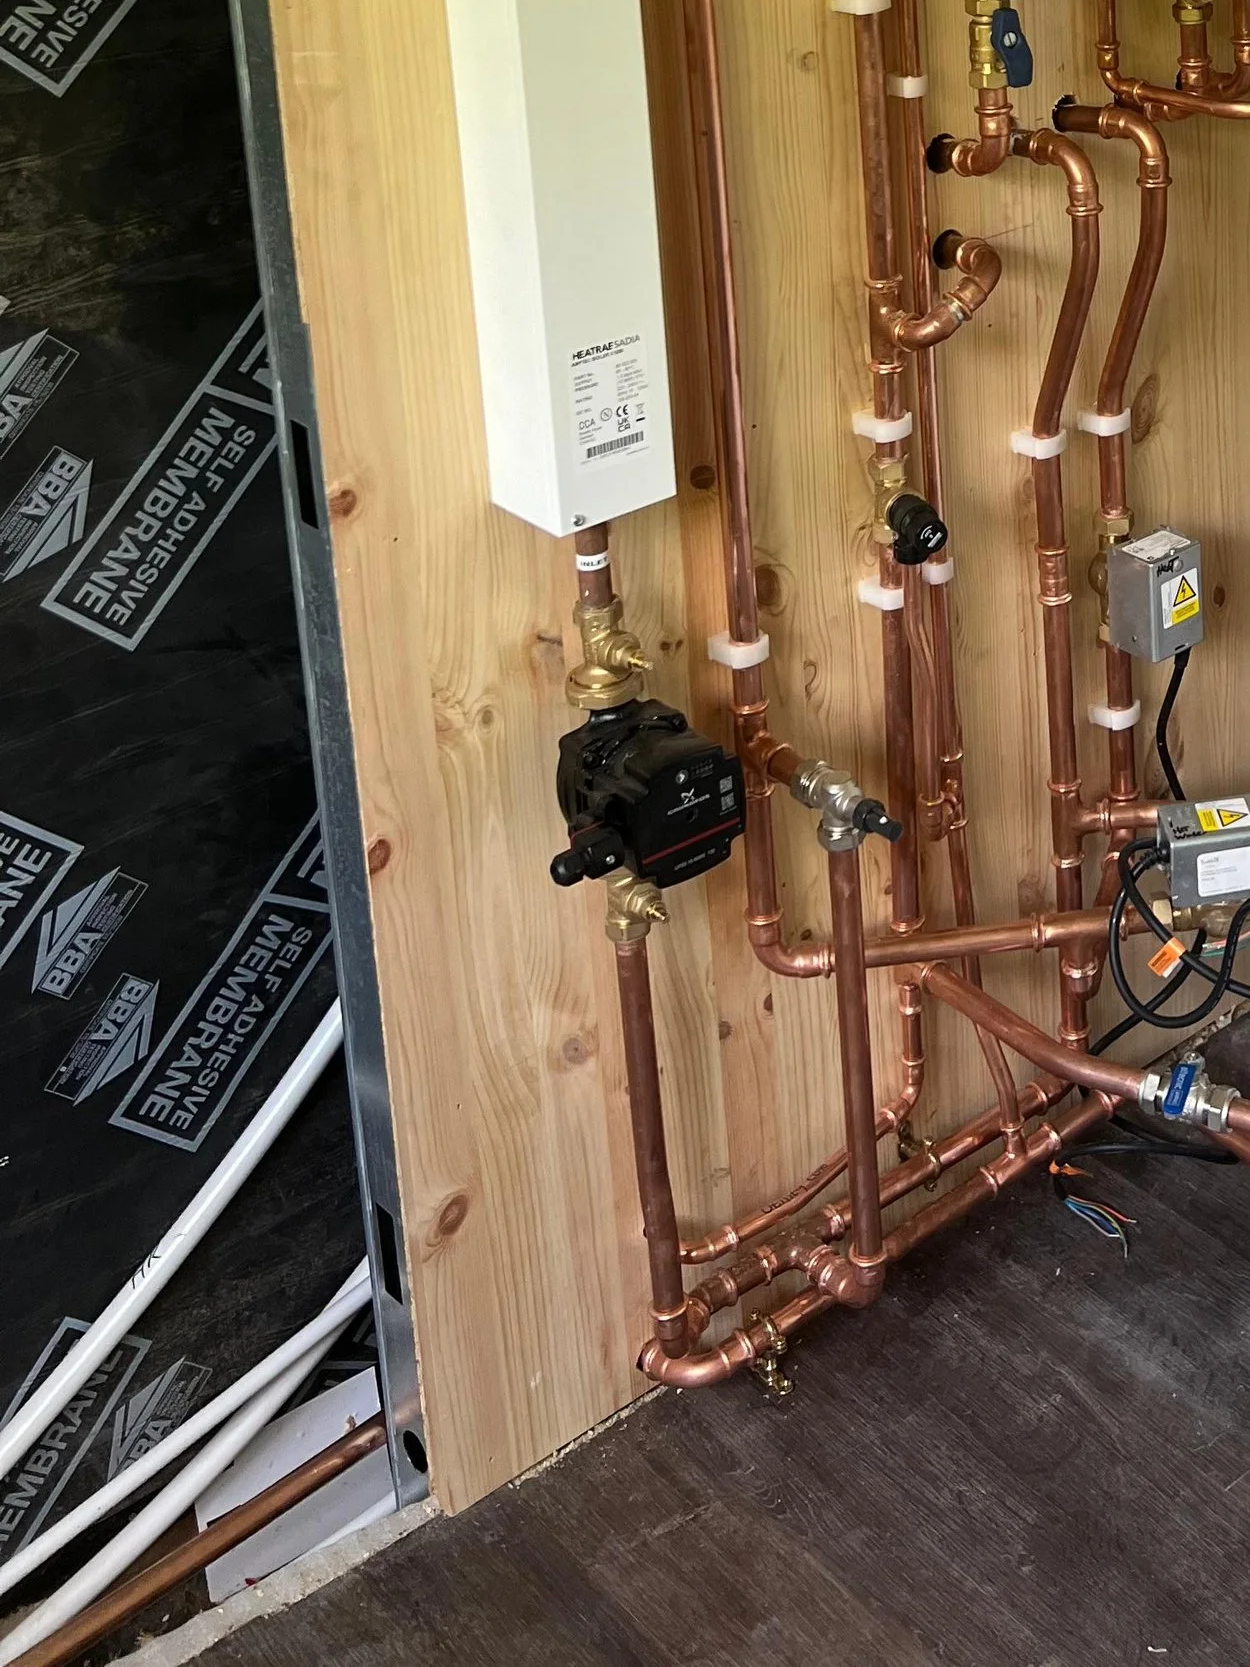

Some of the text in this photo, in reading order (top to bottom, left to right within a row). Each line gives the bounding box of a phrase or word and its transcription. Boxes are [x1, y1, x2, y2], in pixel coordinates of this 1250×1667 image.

[572, 334, 640, 361] HEATRAE SADIA
[0, 393, 34, 439] BA
[19, 452, 83, 520] BBA
[205, 424, 257, 493] SELF
[74, 406, 236, 613] MEMBRANE
[106, 493, 207, 626] ADHESIVE
[40, 931, 103, 995] BBA
[262, 926, 313, 993] SELF
[89, 977, 151, 1041] BBA
[138, 913, 295, 1123] MEMBRANE
[167, 994, 266, 1132] ADHESIVE
[0, 1349, 123, 1550] EMBRANE
[128, 1419, 171, 1461] BA
